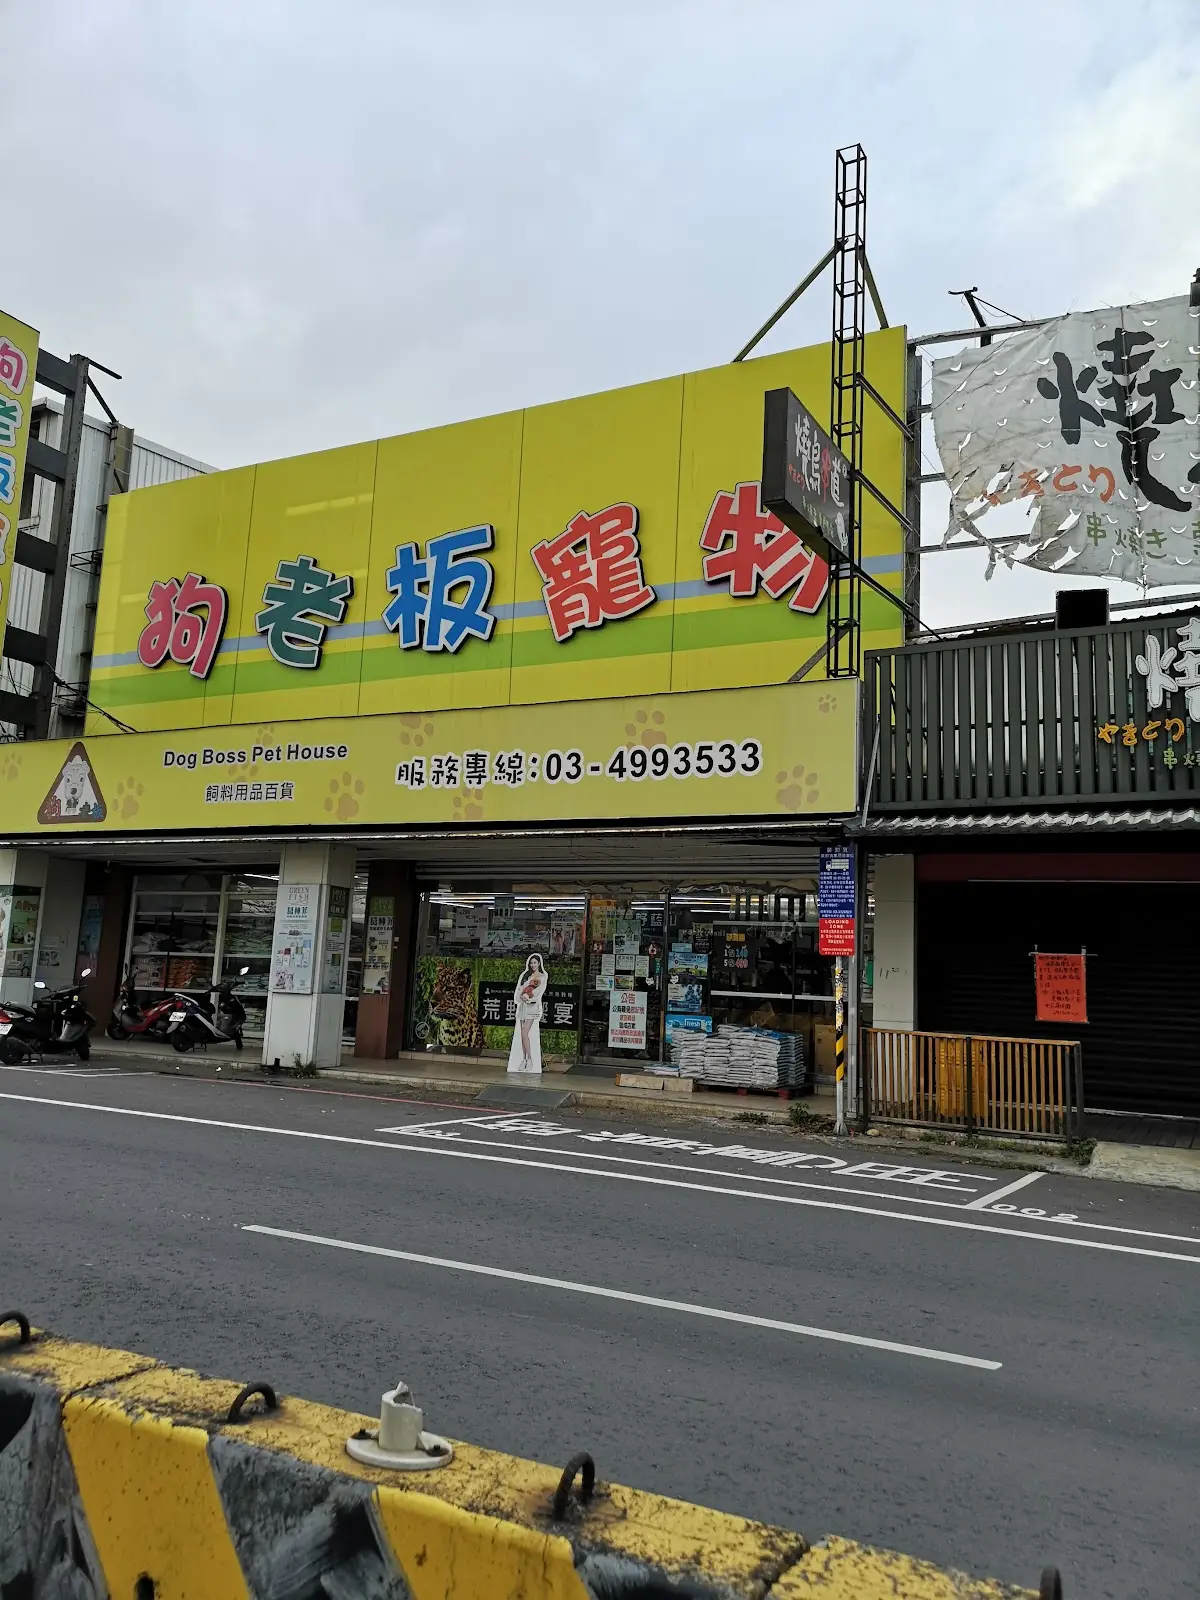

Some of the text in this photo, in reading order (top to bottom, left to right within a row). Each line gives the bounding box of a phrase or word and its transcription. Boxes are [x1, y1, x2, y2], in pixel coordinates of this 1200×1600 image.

[138, 480, 830, 681] 狗老板寵物
[1097, 717, 1185, 746] やきとり
[163, 743, 348, 769] Dog Boss Pet House
[205, 782, 294, 802] 飼料用品百貨
[620, 992, 636, 1005] 公告
[991, 1203, 1079, 1222] 002
